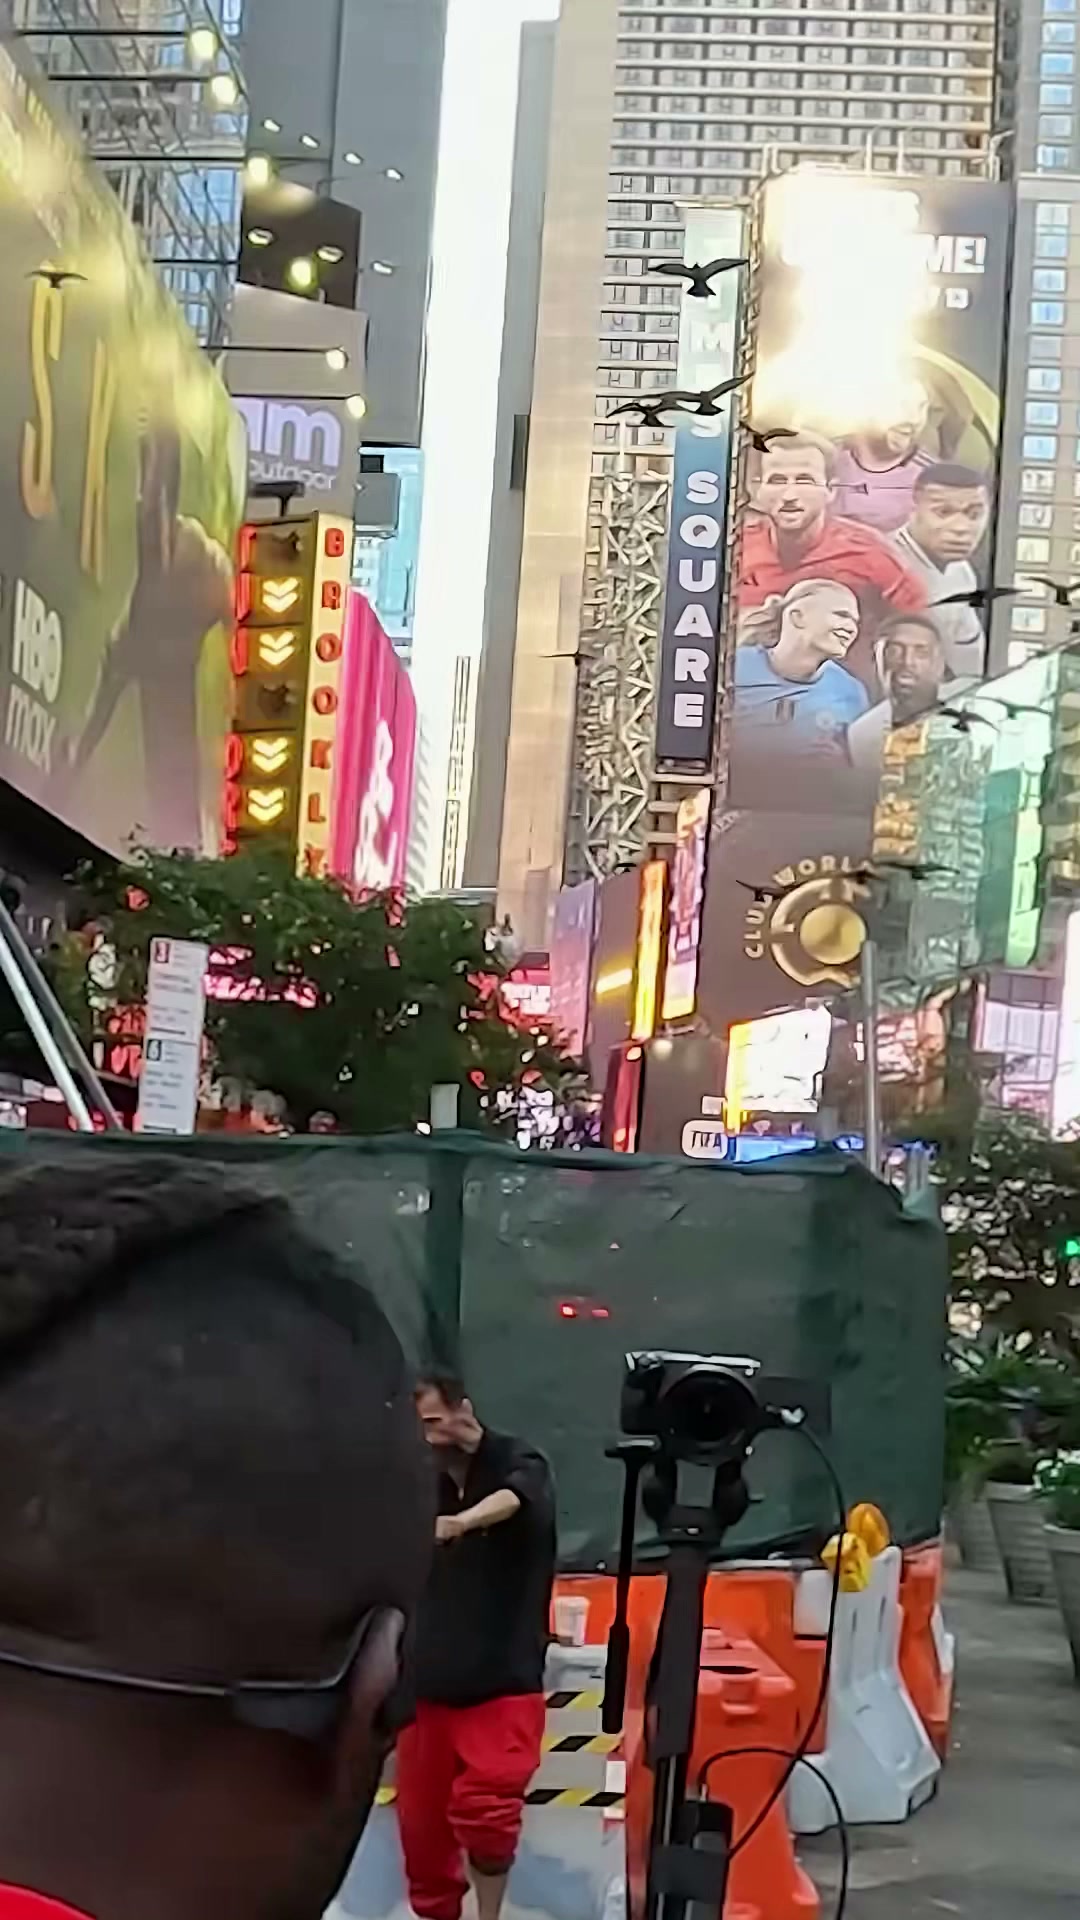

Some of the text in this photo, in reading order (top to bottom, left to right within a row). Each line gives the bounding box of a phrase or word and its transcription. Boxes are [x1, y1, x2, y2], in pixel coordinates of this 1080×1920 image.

[12, 577, 62, 704] HBO
[673, 470, 721, 728] SQUARE
[5, 683, 57, 774] max
